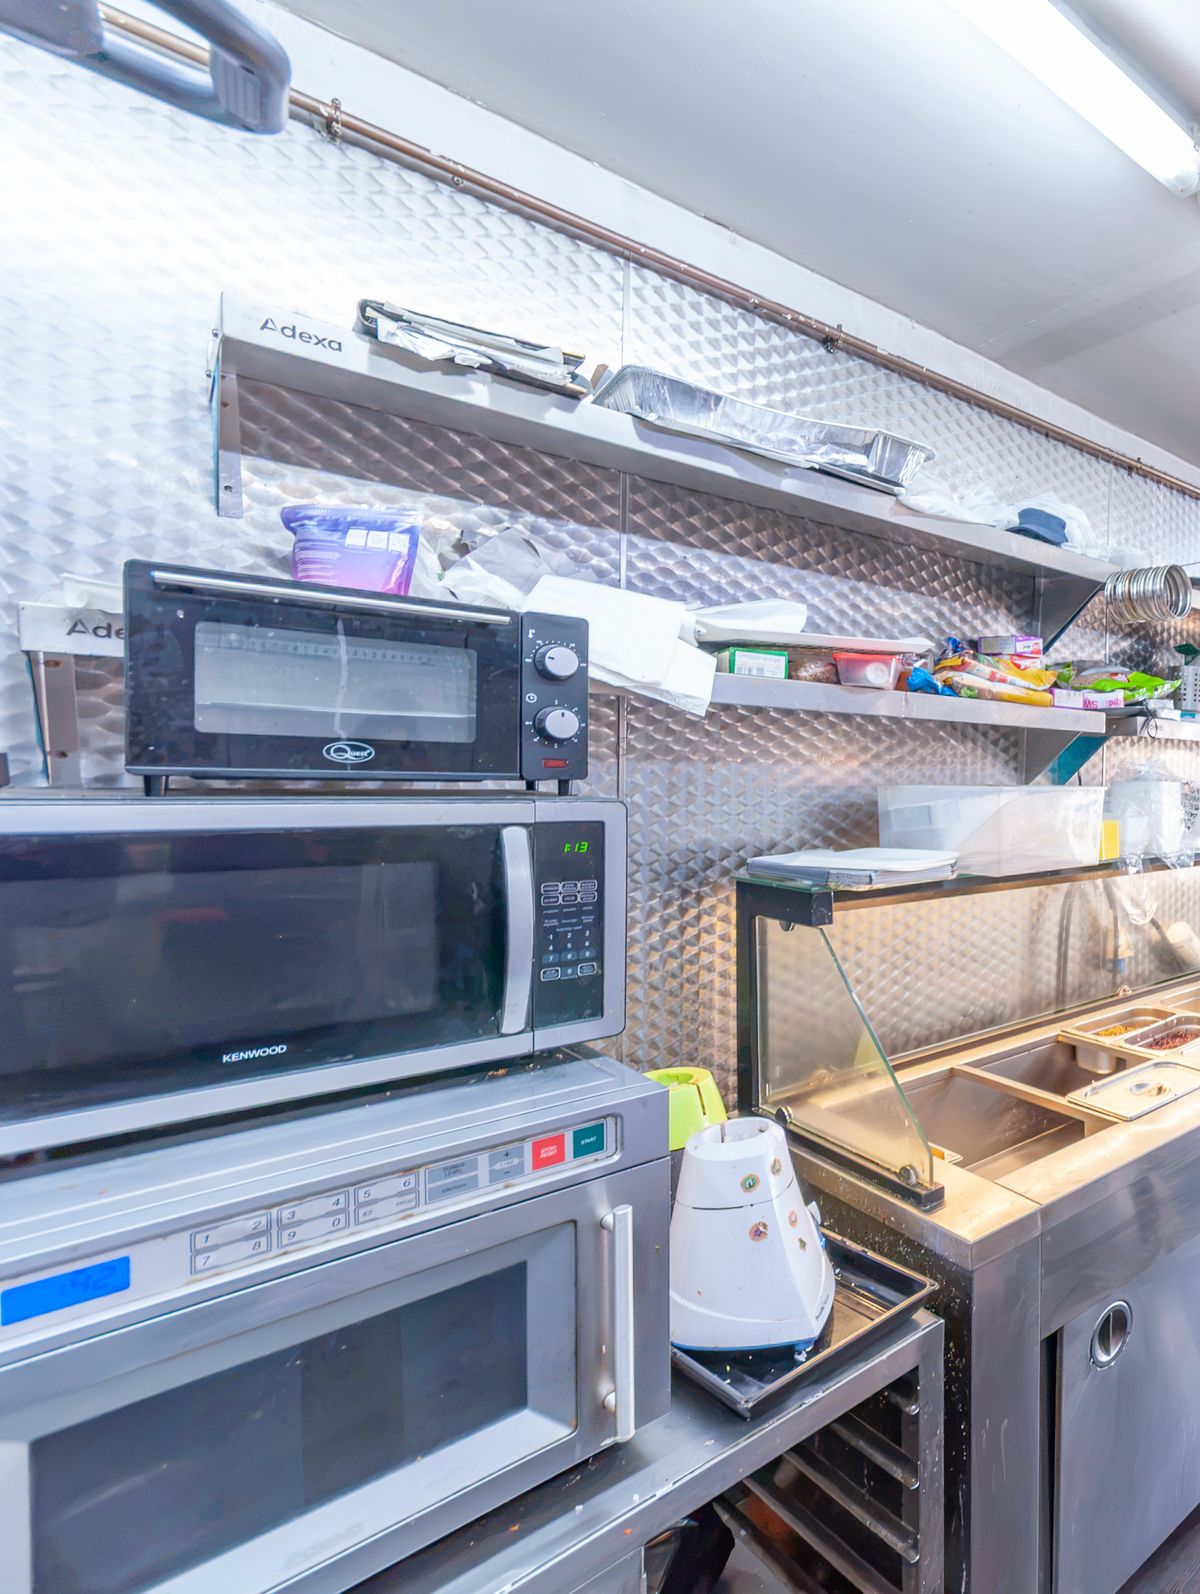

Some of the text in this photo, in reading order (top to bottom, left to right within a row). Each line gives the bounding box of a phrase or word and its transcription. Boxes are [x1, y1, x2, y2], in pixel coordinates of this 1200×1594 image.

[259, 317, 342, 353] Adexa
[222, 1045, 287, 1063] KENWOOD
[402, 1179, 411, 1187] 6
[363, 1189, 371, 1198] 5
[332, 1198, 340, 1207] 4
[286, 1210, 296, 1220] 3
[251, 1221, 262, 1231] 2
[332, 1217, 340, 1227] 0
[203, 1234, 210, 1243] 1
[287, 1231, 296, 1240] 9
[252, 1241, 262, 1250] 8
[202, 1256, 211, 1266] 7
